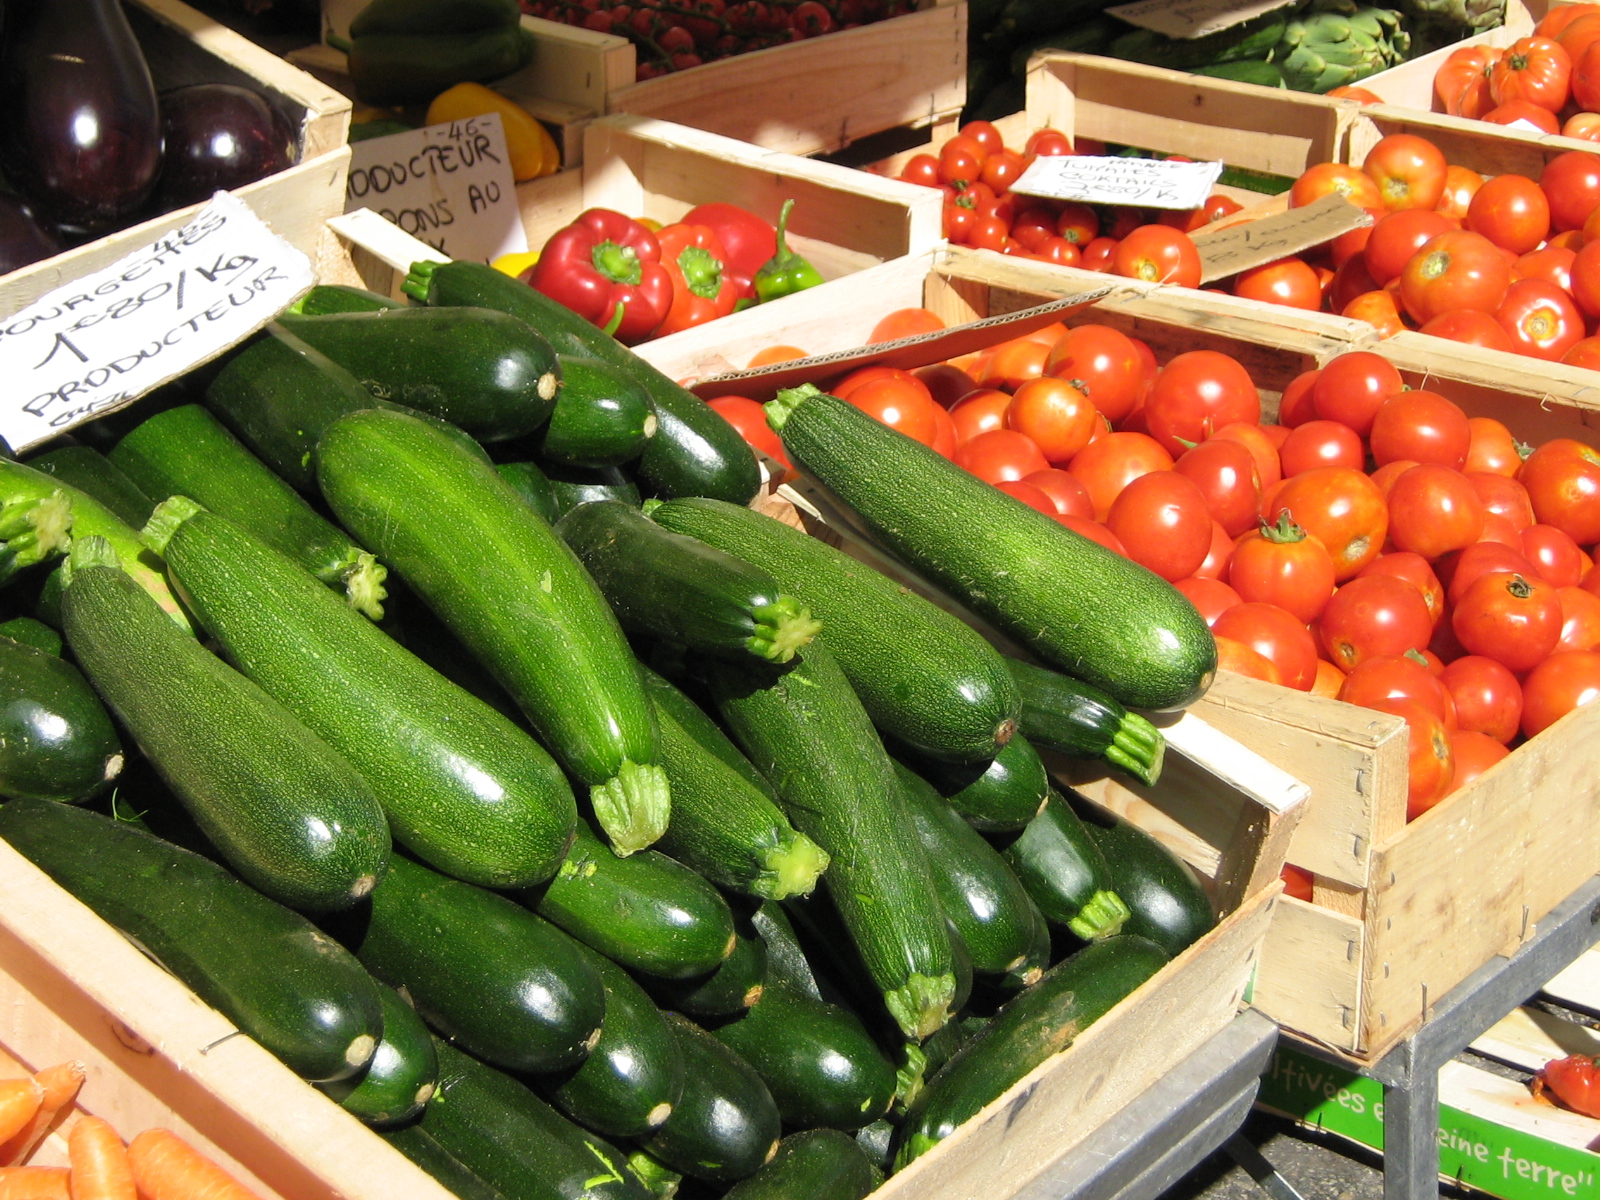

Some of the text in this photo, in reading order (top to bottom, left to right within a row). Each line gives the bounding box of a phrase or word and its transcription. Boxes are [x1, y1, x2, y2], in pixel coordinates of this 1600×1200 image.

[468, 180, 501, 214] AU
[0, 216, 227, 342] OURGETTES
[22, 266, 289, 417] PRODUCTEUR
